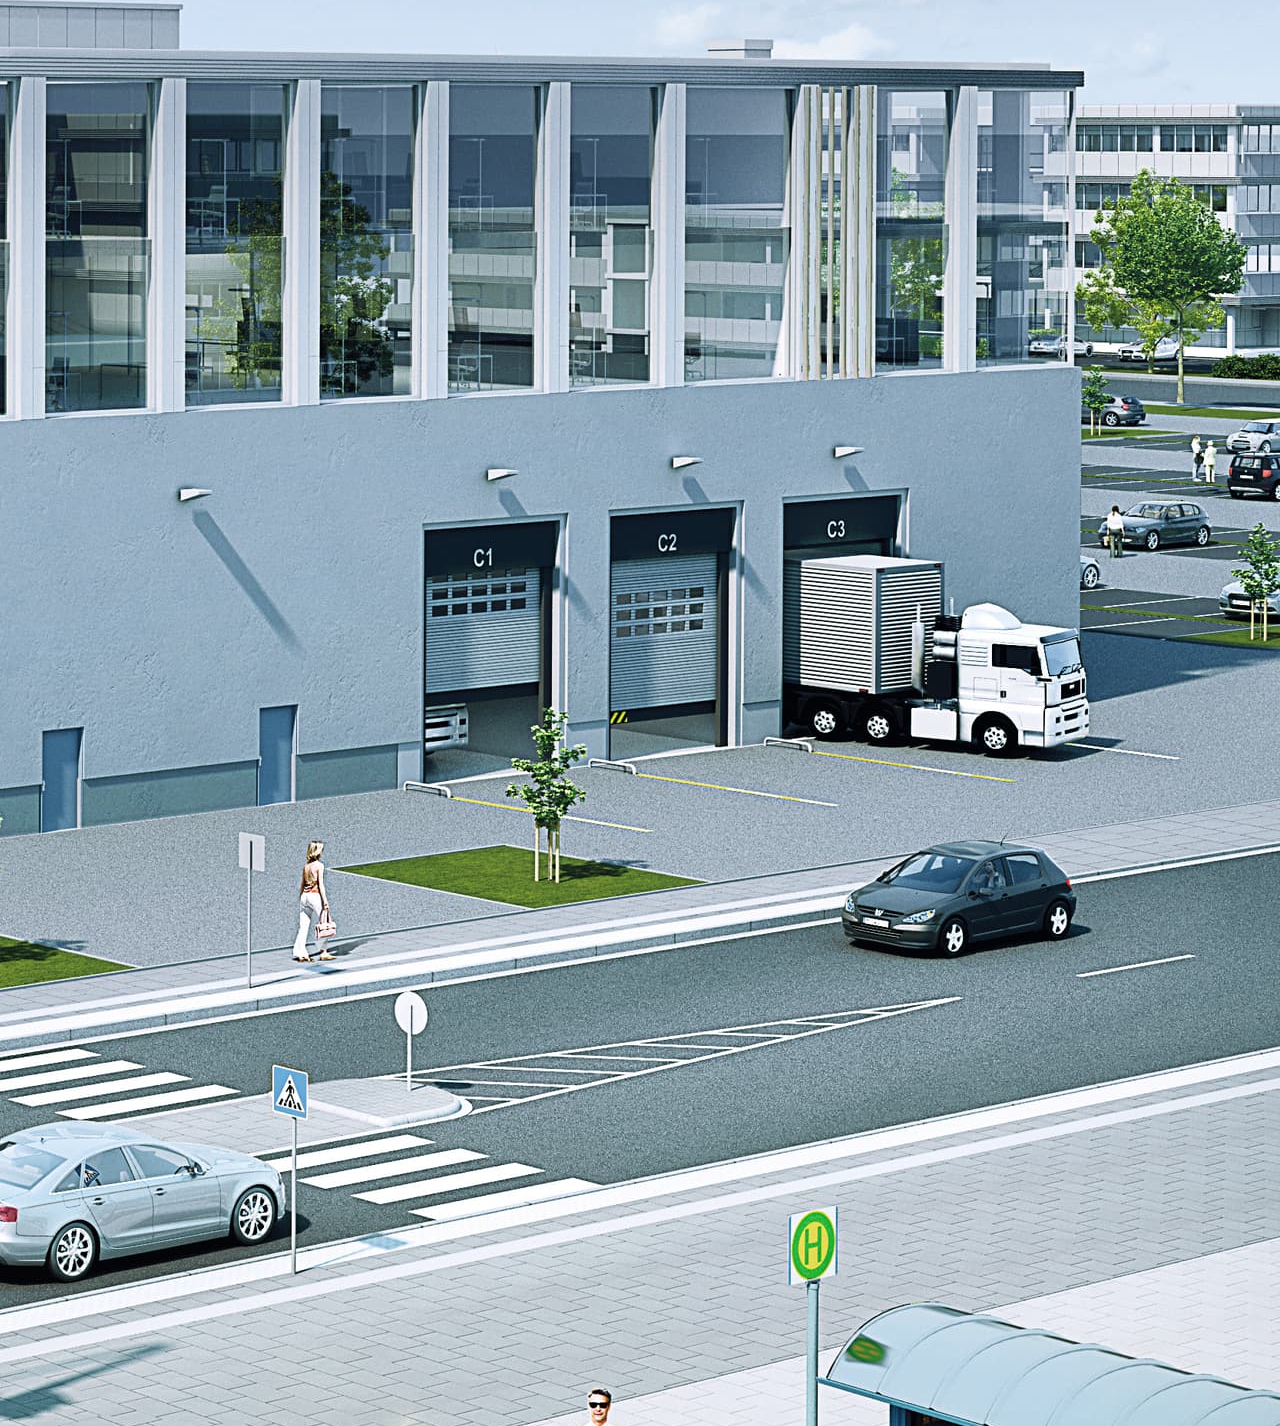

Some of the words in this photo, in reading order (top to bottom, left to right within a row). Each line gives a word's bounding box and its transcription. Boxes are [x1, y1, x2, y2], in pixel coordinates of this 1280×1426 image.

[827, 520, 846, 539] C3
[658, 533, 677, 552] C2
[473, 547, 493, 568] C1
[804, 1225, 822, 1265] H
